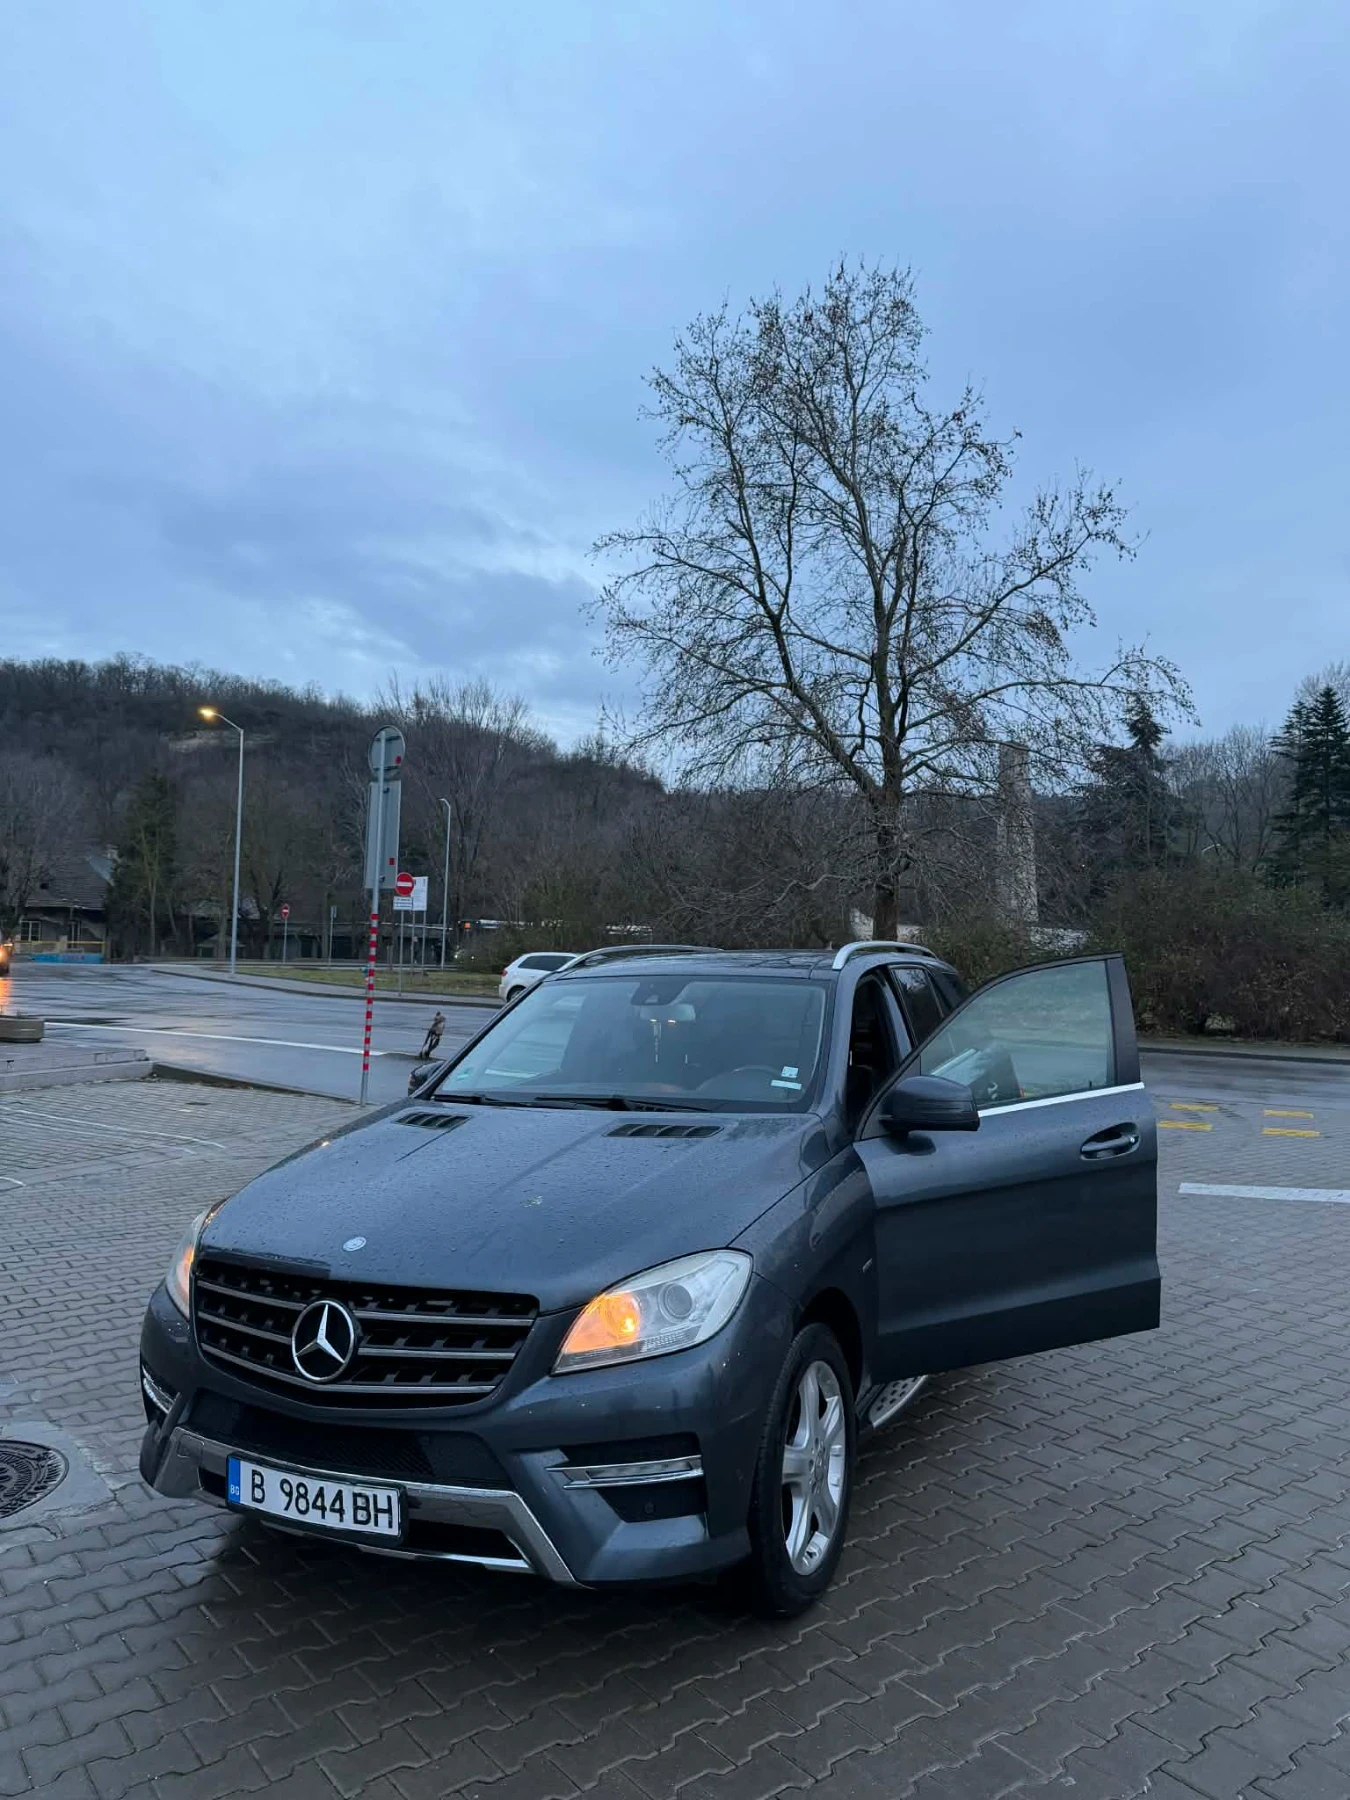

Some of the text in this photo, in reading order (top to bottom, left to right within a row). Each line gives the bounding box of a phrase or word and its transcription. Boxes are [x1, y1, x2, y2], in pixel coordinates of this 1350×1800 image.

[230, 1484, 240, 1496] BG
[251, 1469, 394, 1529] B 9844 BH
